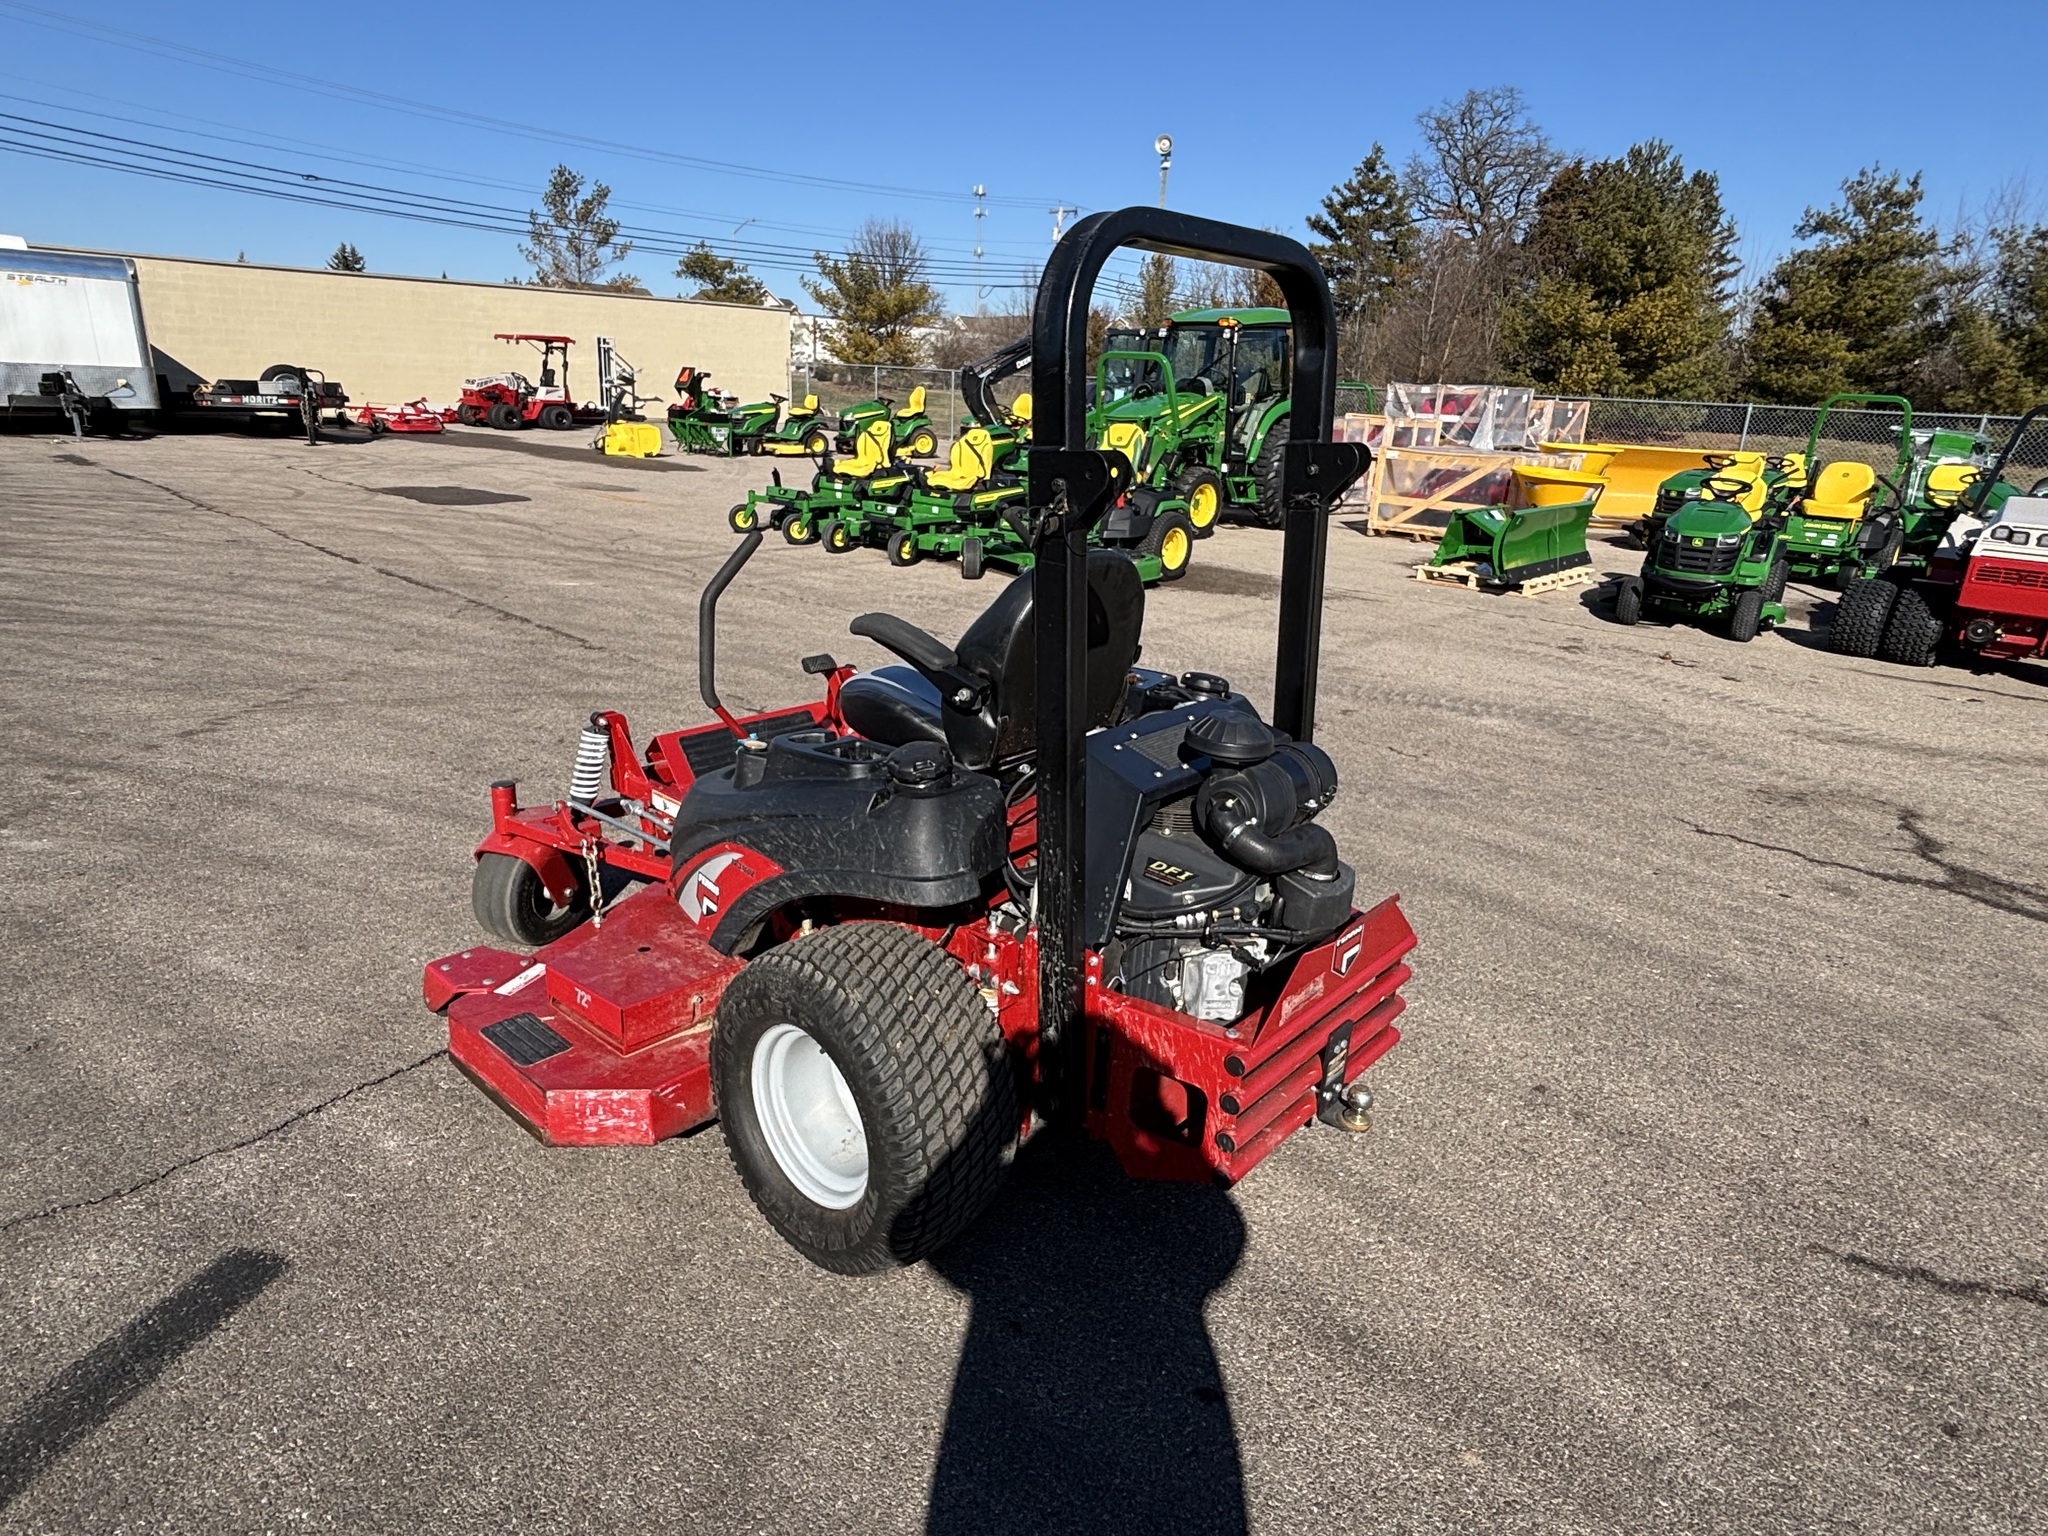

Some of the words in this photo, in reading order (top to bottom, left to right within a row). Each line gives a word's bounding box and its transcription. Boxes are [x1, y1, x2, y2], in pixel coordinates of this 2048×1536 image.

[6, 273, 68, 286] STEALTH
[241, 395, 279, 404] MORITZ
[1149, 860, 1194, 881] DFI
